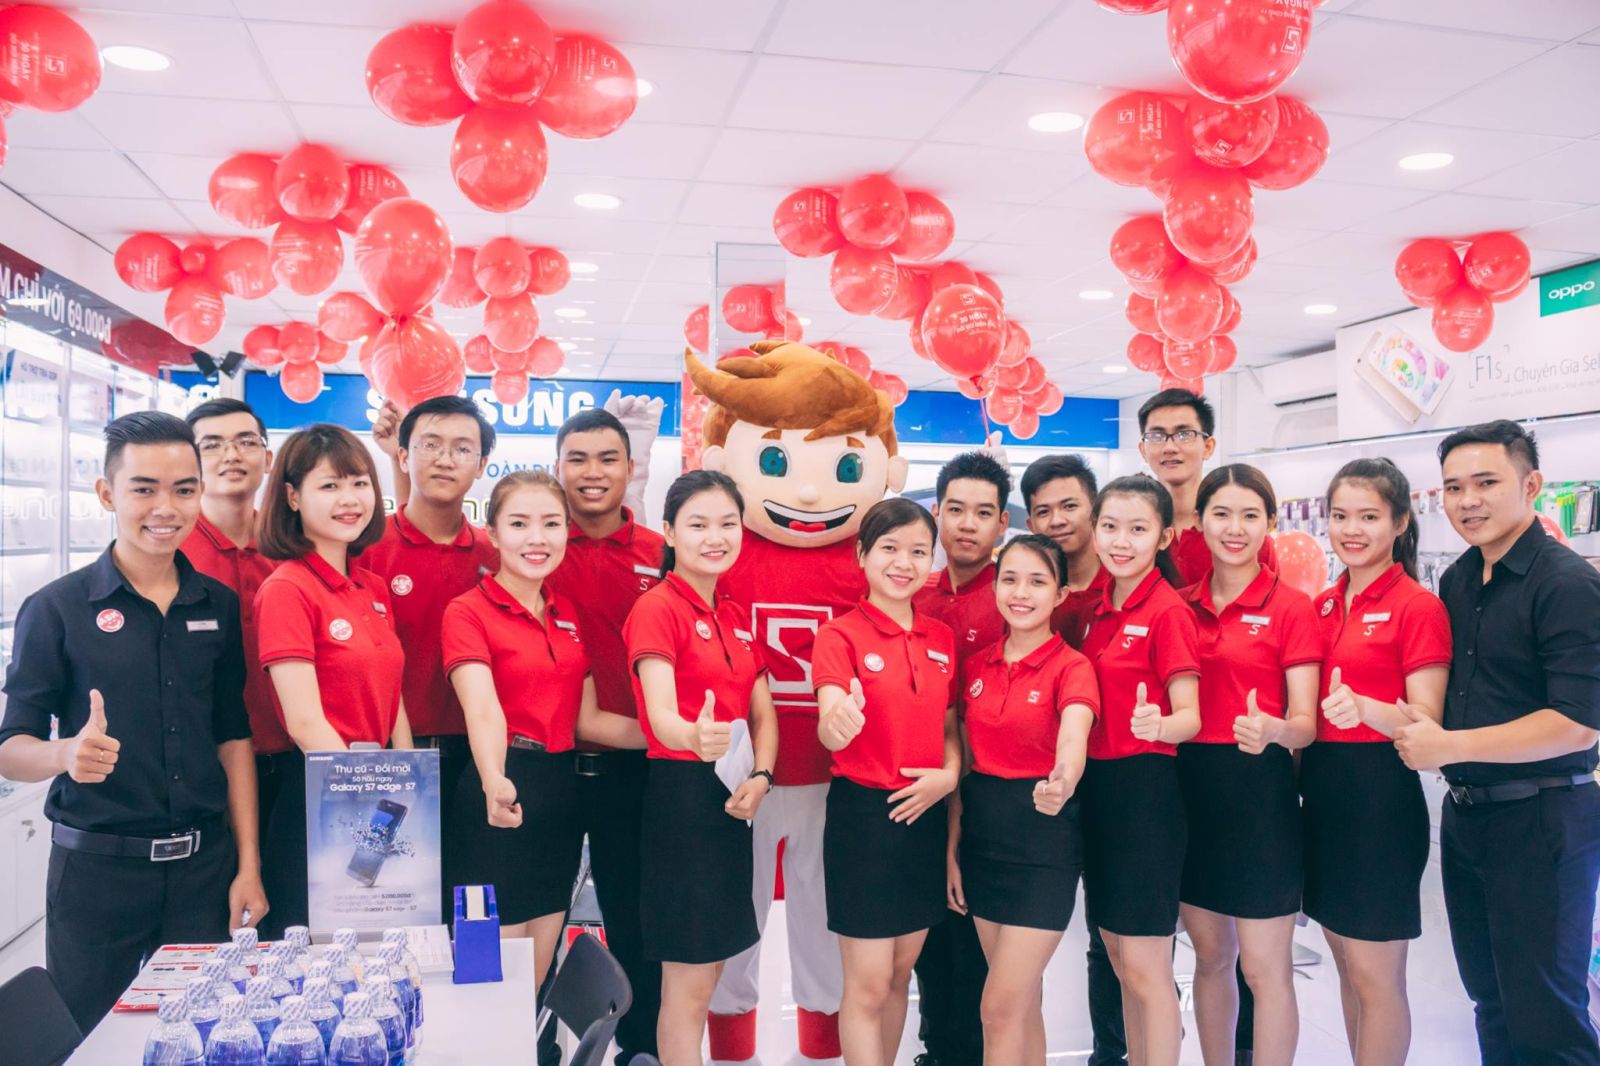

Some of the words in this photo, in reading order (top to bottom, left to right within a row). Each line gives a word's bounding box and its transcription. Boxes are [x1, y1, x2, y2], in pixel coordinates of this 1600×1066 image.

[1549, 280, 1596, 300] oppo
[42, 284, 65, 324] VỚI
[1560, 357, 1580, 376] Gia
[334, 764, 353, 774] Thu
[354, 764, 368, 774] cũ
[330, 783, 363, 794] Galaxy
[364, 783, 376, 792] S7
[377, 782, 402, 794] edge
[405, 782, 416, 791] S7
